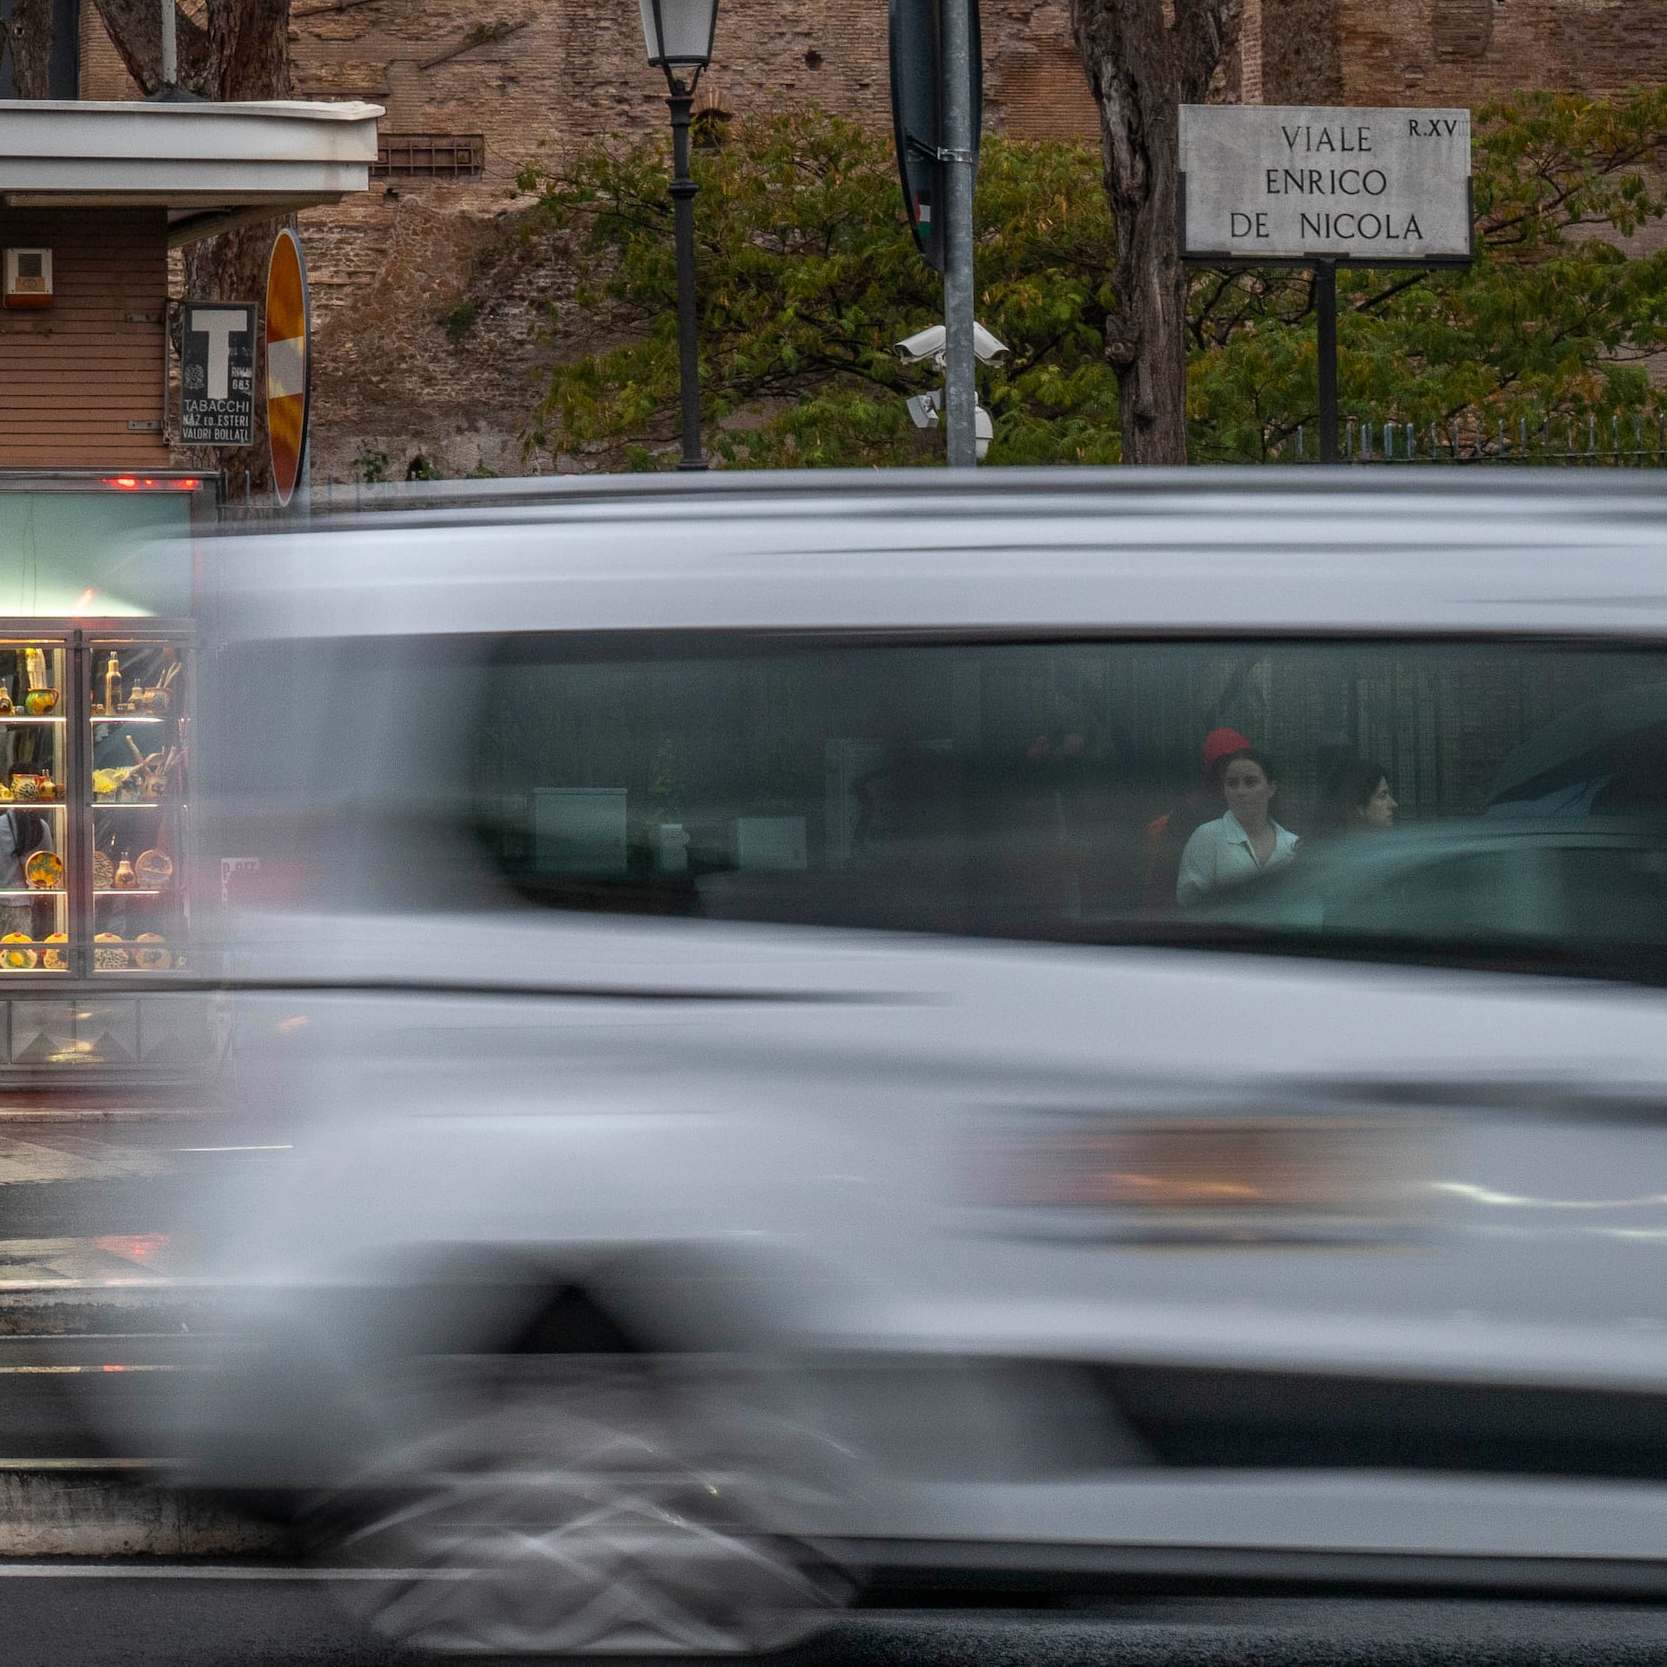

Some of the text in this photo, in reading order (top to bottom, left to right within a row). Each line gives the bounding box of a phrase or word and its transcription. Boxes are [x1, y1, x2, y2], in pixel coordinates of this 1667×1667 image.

[1281, 126, 1372, 152] VIALE
[1266, 169, 1387, 195] ENRICO
[1230, 212, 1424, 239] DE NICOLA
[191, 309, 247, 399] T
[184, 399, 249, 414] TABACCHI
[182, 427, 211, 440] VALORI
[218, 414, 249, 427] ESTERI
